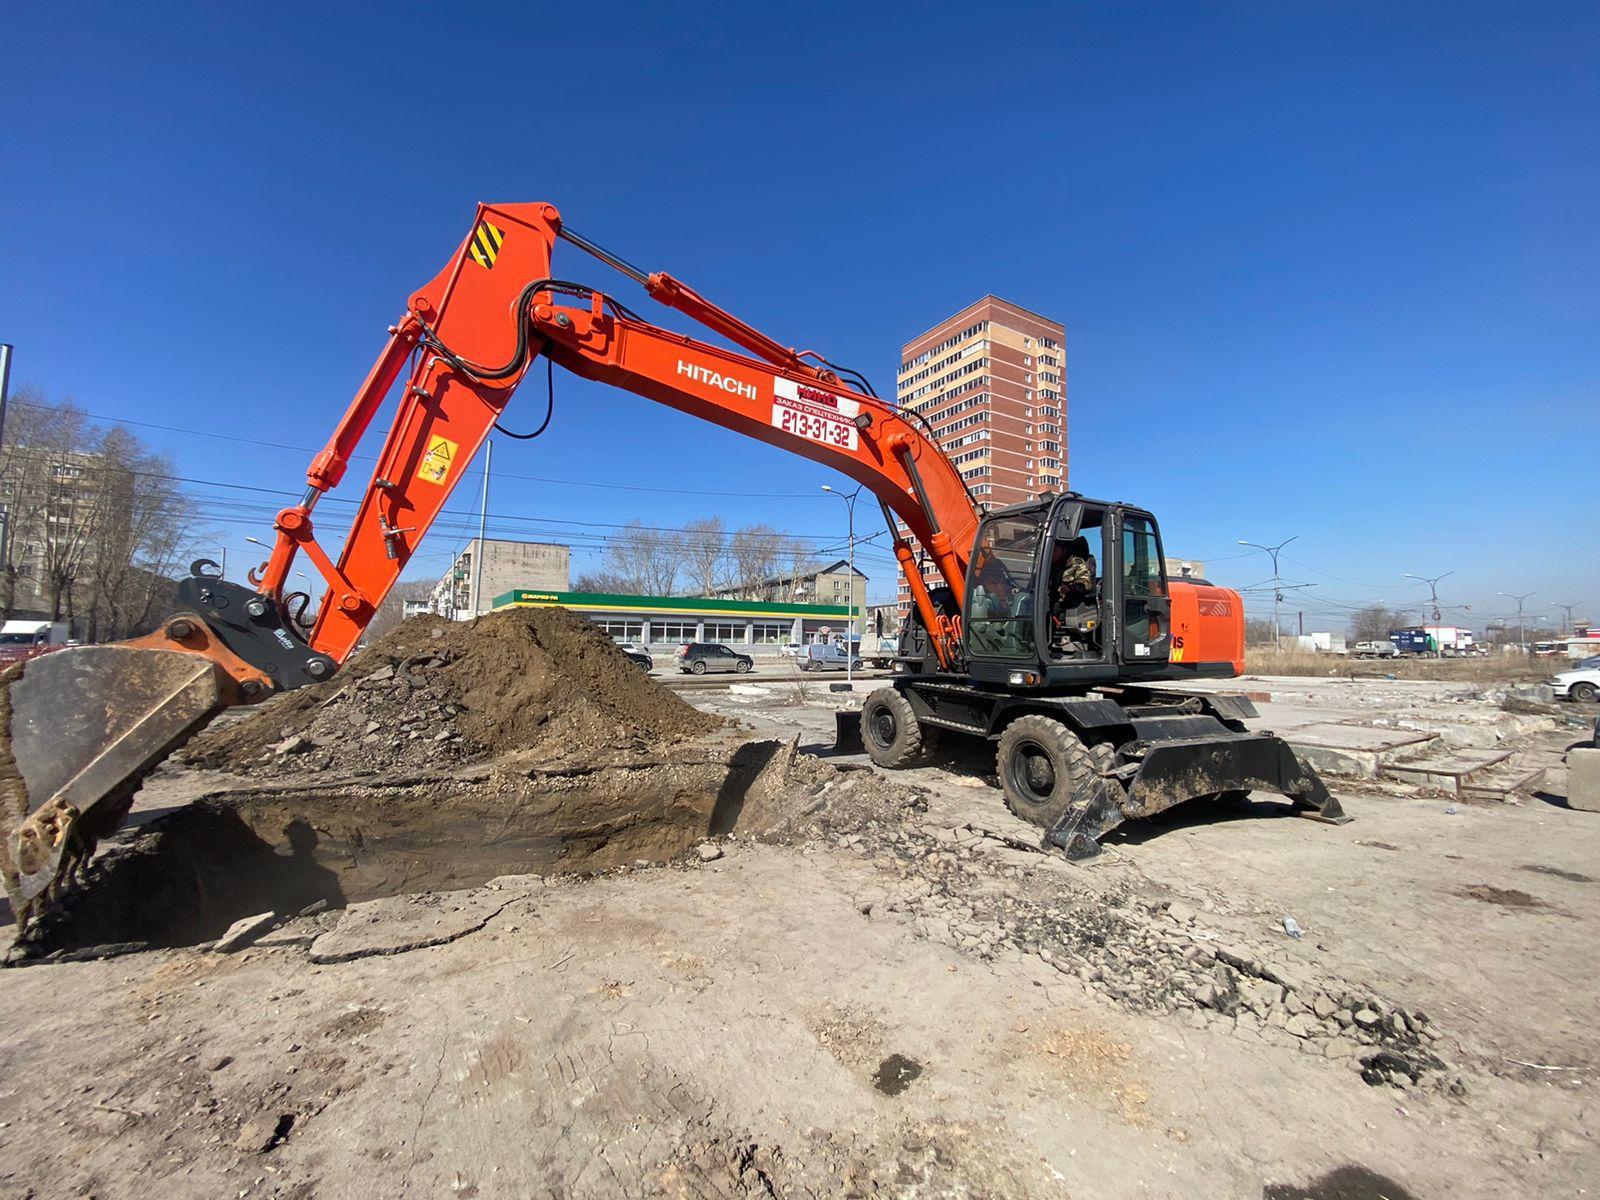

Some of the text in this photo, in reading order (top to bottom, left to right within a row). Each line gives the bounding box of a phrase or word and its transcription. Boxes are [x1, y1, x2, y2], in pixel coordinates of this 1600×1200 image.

[677, 359, 757, 400] HITACHI
[776, 399, 803, 411] ЗАКАЗ
[782, 409, 849, 447] 213-31-32
